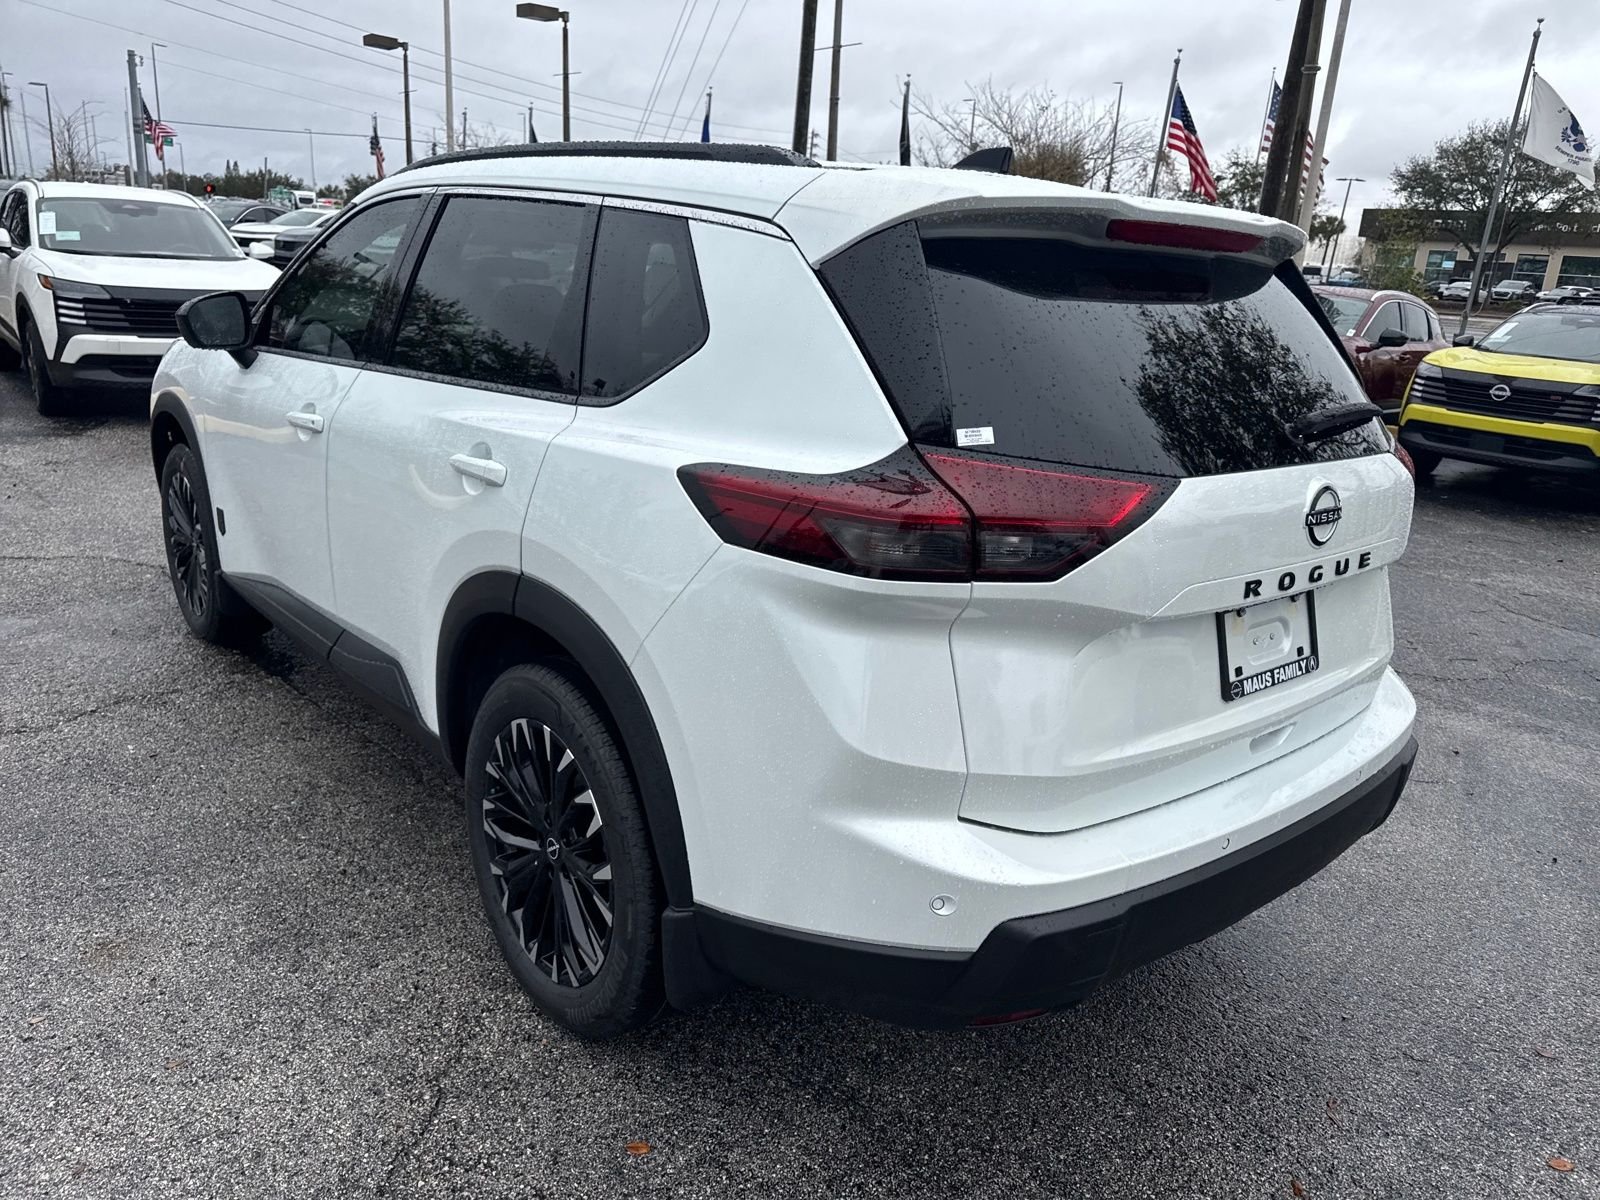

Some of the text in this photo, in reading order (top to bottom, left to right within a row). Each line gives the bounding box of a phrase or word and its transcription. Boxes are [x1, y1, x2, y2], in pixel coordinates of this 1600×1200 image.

[1243, 551, 1371, 599] ROGUE
[1243, 659, 1307, 695] MAUS FAMILY
